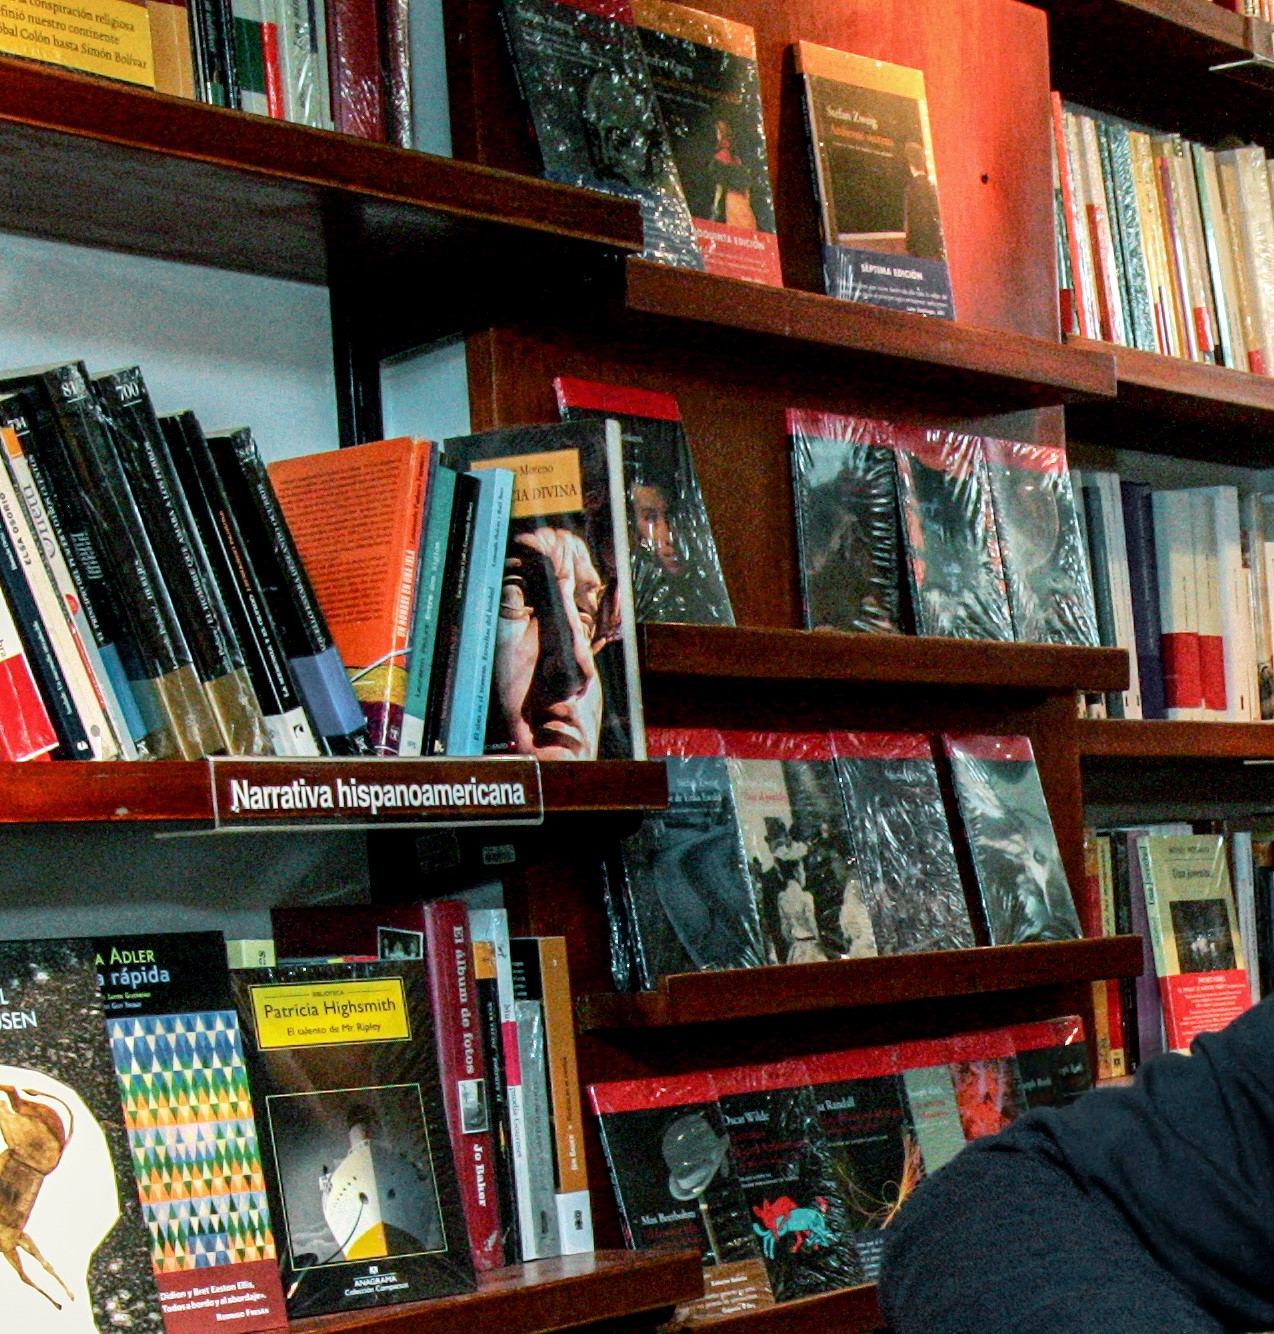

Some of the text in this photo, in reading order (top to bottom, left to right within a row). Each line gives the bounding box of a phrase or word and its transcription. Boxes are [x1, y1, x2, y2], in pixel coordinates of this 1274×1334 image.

[27, 14, 66, 31] nuestro
[68, 24, 120, 45] continente
[95, 12, 135, 32] religiosa
[20, 28, 50, 45] Colón
[53, 35, 79, 52] hasta
[81, 43, 112, 60] Simón
[115, 52, 147, 69] Bolívar
[115, 382, 140, 401] 700
[142, 440, 163, 481] PERROS
[518, 464, 554, 477] Moreno
[157, 480, 170, 501] LOS
[532, 483, 578, 499] DIVINA
[0, 492, 32, 567] ELSA OSORIO
[167, 509, 185, 541] AMABA
[178, 540, 194, 567] QUE
[404, 549, 416, 567] ISLA
[187, 567, 210, 611] HOMBRE
[231, 777, 526, 815] Narrativa hispanoamericana
[109, 947, 156, 965] ADLER
[111, 966, 171, 989] rápida
[264, 998, 396, 1019] Patricia Highsmith
[453, 925, 475, 1076] El álbum de fotos
[287, 1027, 295, 1036] El
[297, 1026, 327, 1035] talento
[329, 1025, 339, 1033] de
[356, 1022, 381, 1033] Ripley
[473, 1143, 487, 1208] Jo Baker
[193, 1287, 209, 1298] Bret
[210, 1284, 236, 1296] Easton
[353, 1275, 398, 1288] ANAGRAMA
